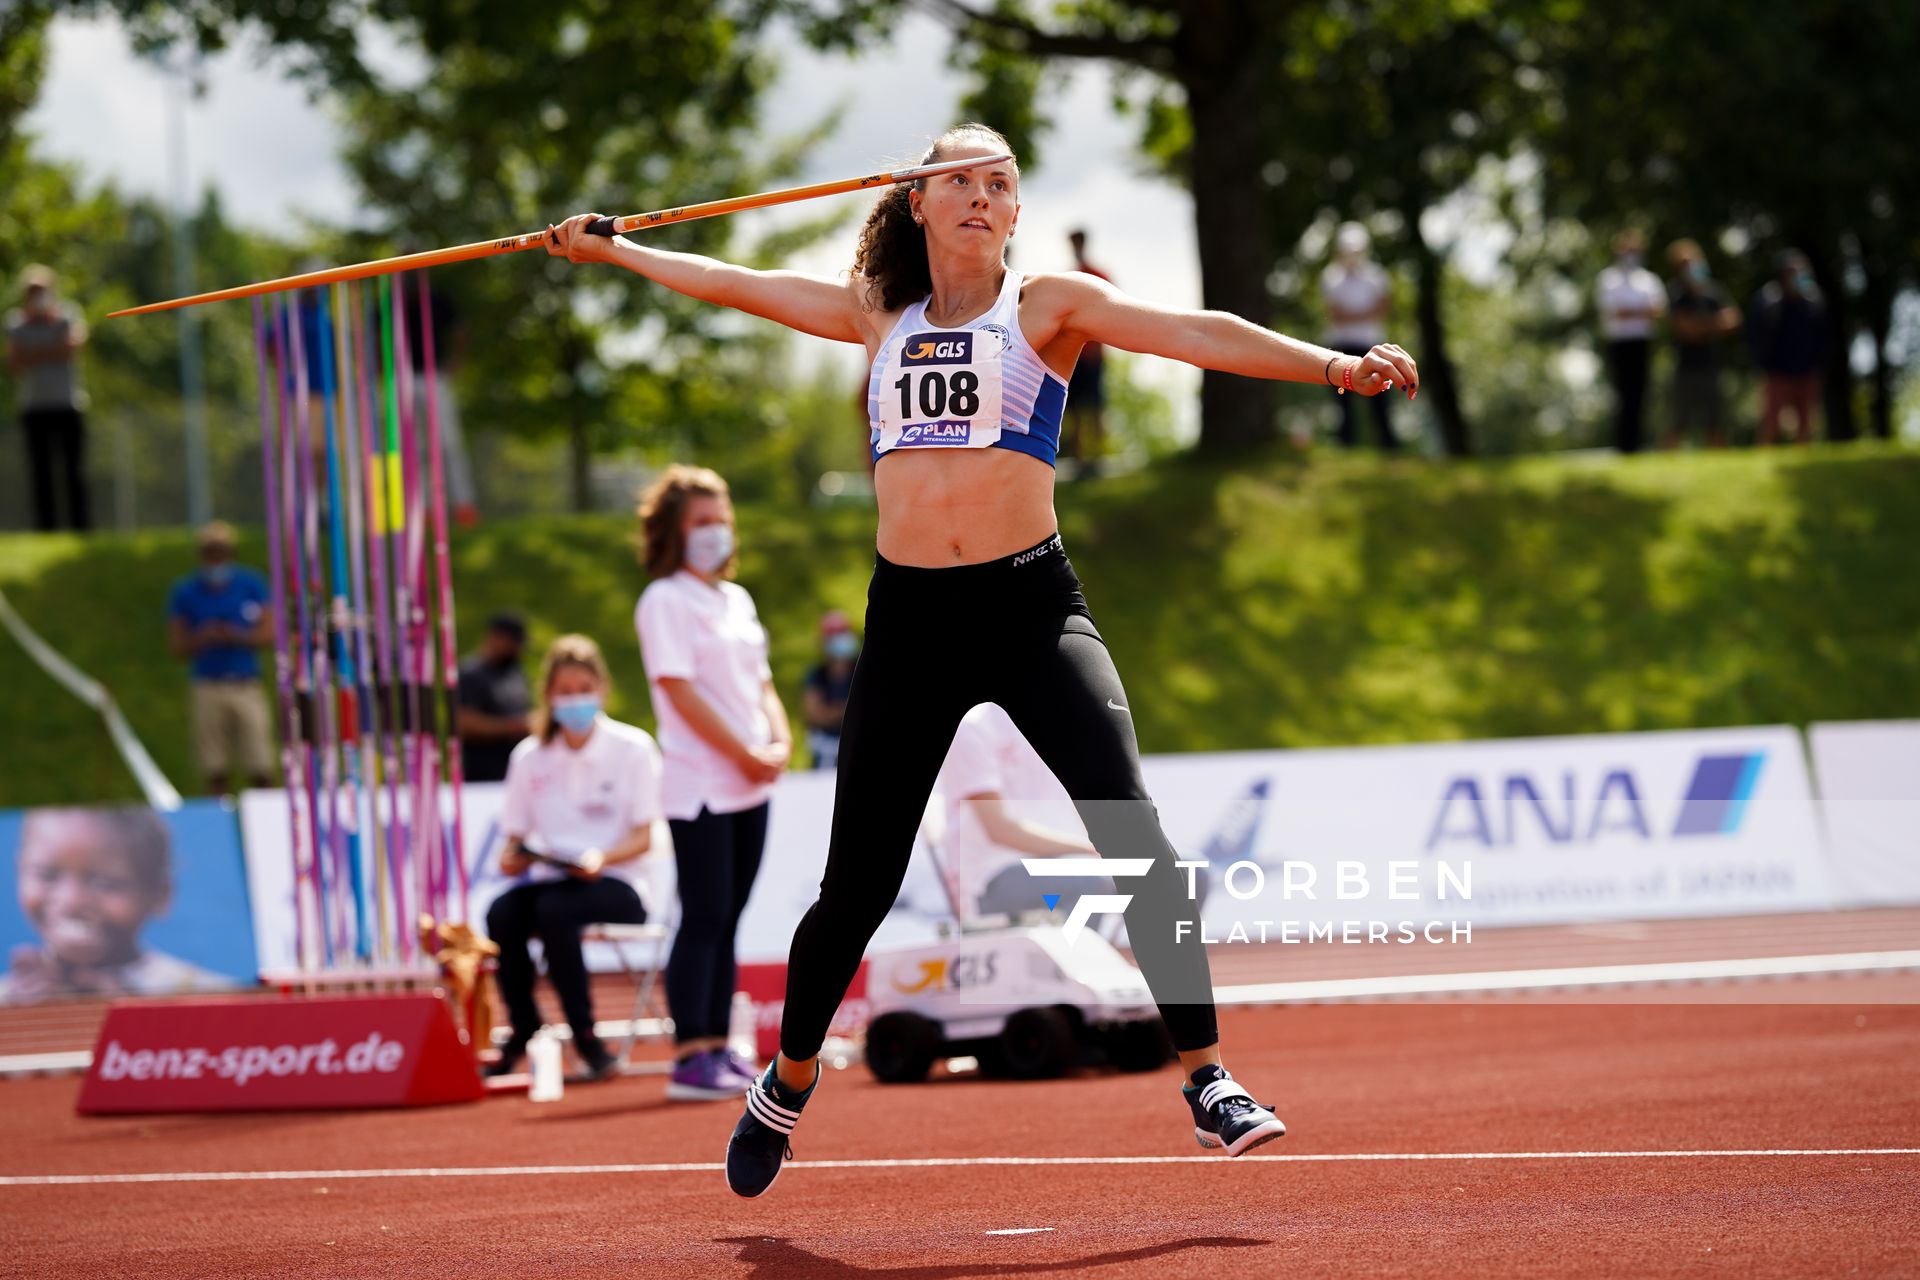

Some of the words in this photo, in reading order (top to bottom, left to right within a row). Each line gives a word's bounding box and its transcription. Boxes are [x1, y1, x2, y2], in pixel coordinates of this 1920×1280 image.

[935, 341, 965, 358] GLS
[895, 371, 979, 419] 108
[923, 424, 967, 436] PLAN
[1425, 771, 1651, 849] ANA
[949, 951, 1000, 987] GLS
[100, 1031, 405, 1086] benz-sport.de
